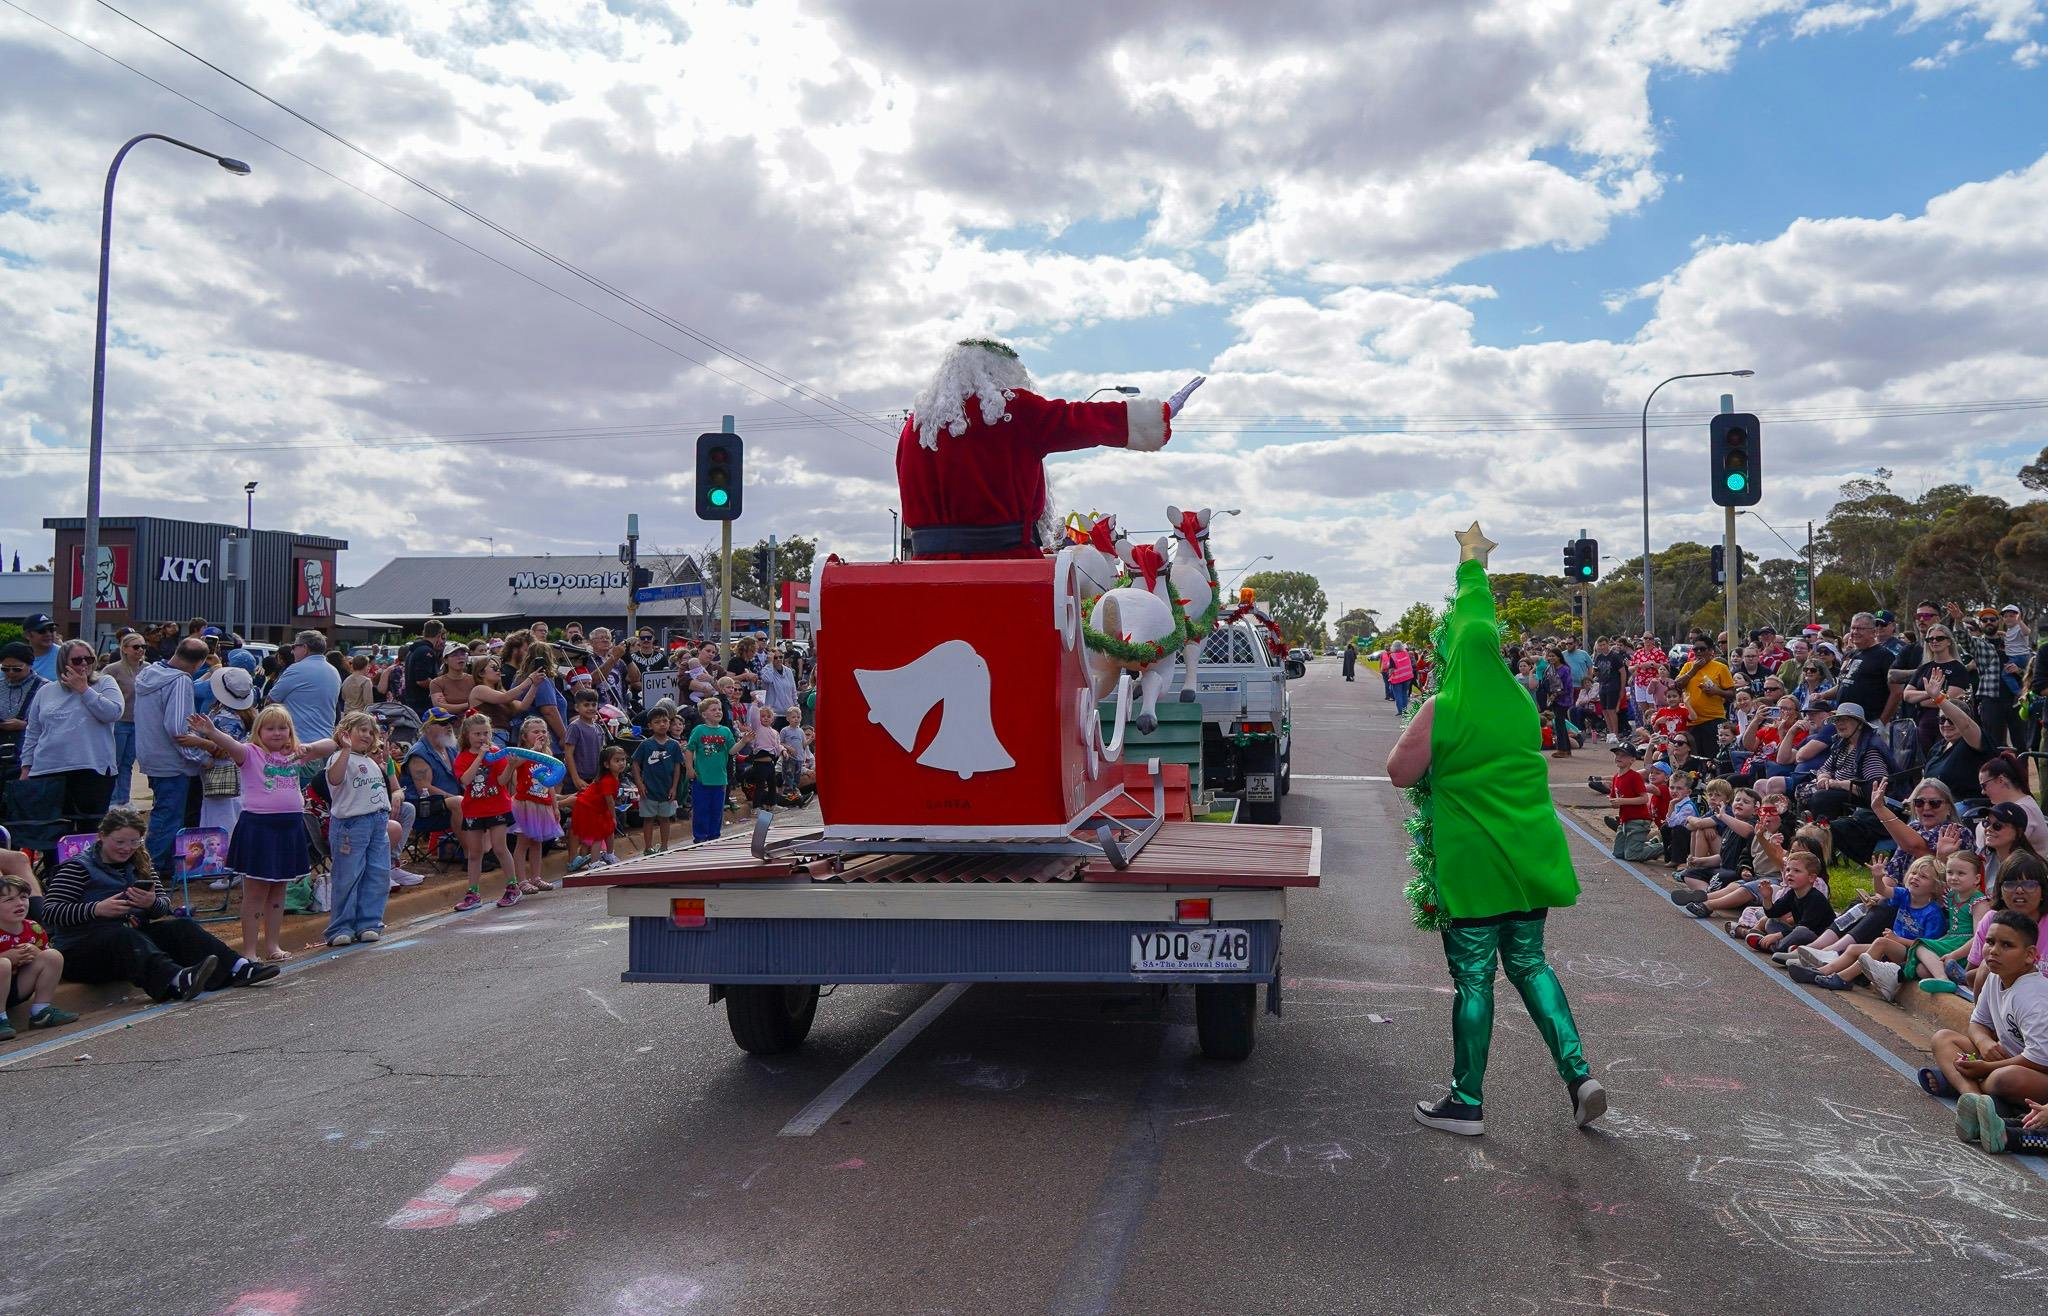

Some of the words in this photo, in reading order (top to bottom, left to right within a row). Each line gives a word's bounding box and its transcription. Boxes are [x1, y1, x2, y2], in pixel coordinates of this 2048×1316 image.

[160, 556, 211, 583] KFC
[646, 679, 667, 689] GIVE
[1136, 933, 1189, 961] YDQ
[1203, 933, 1248, 961] 748
